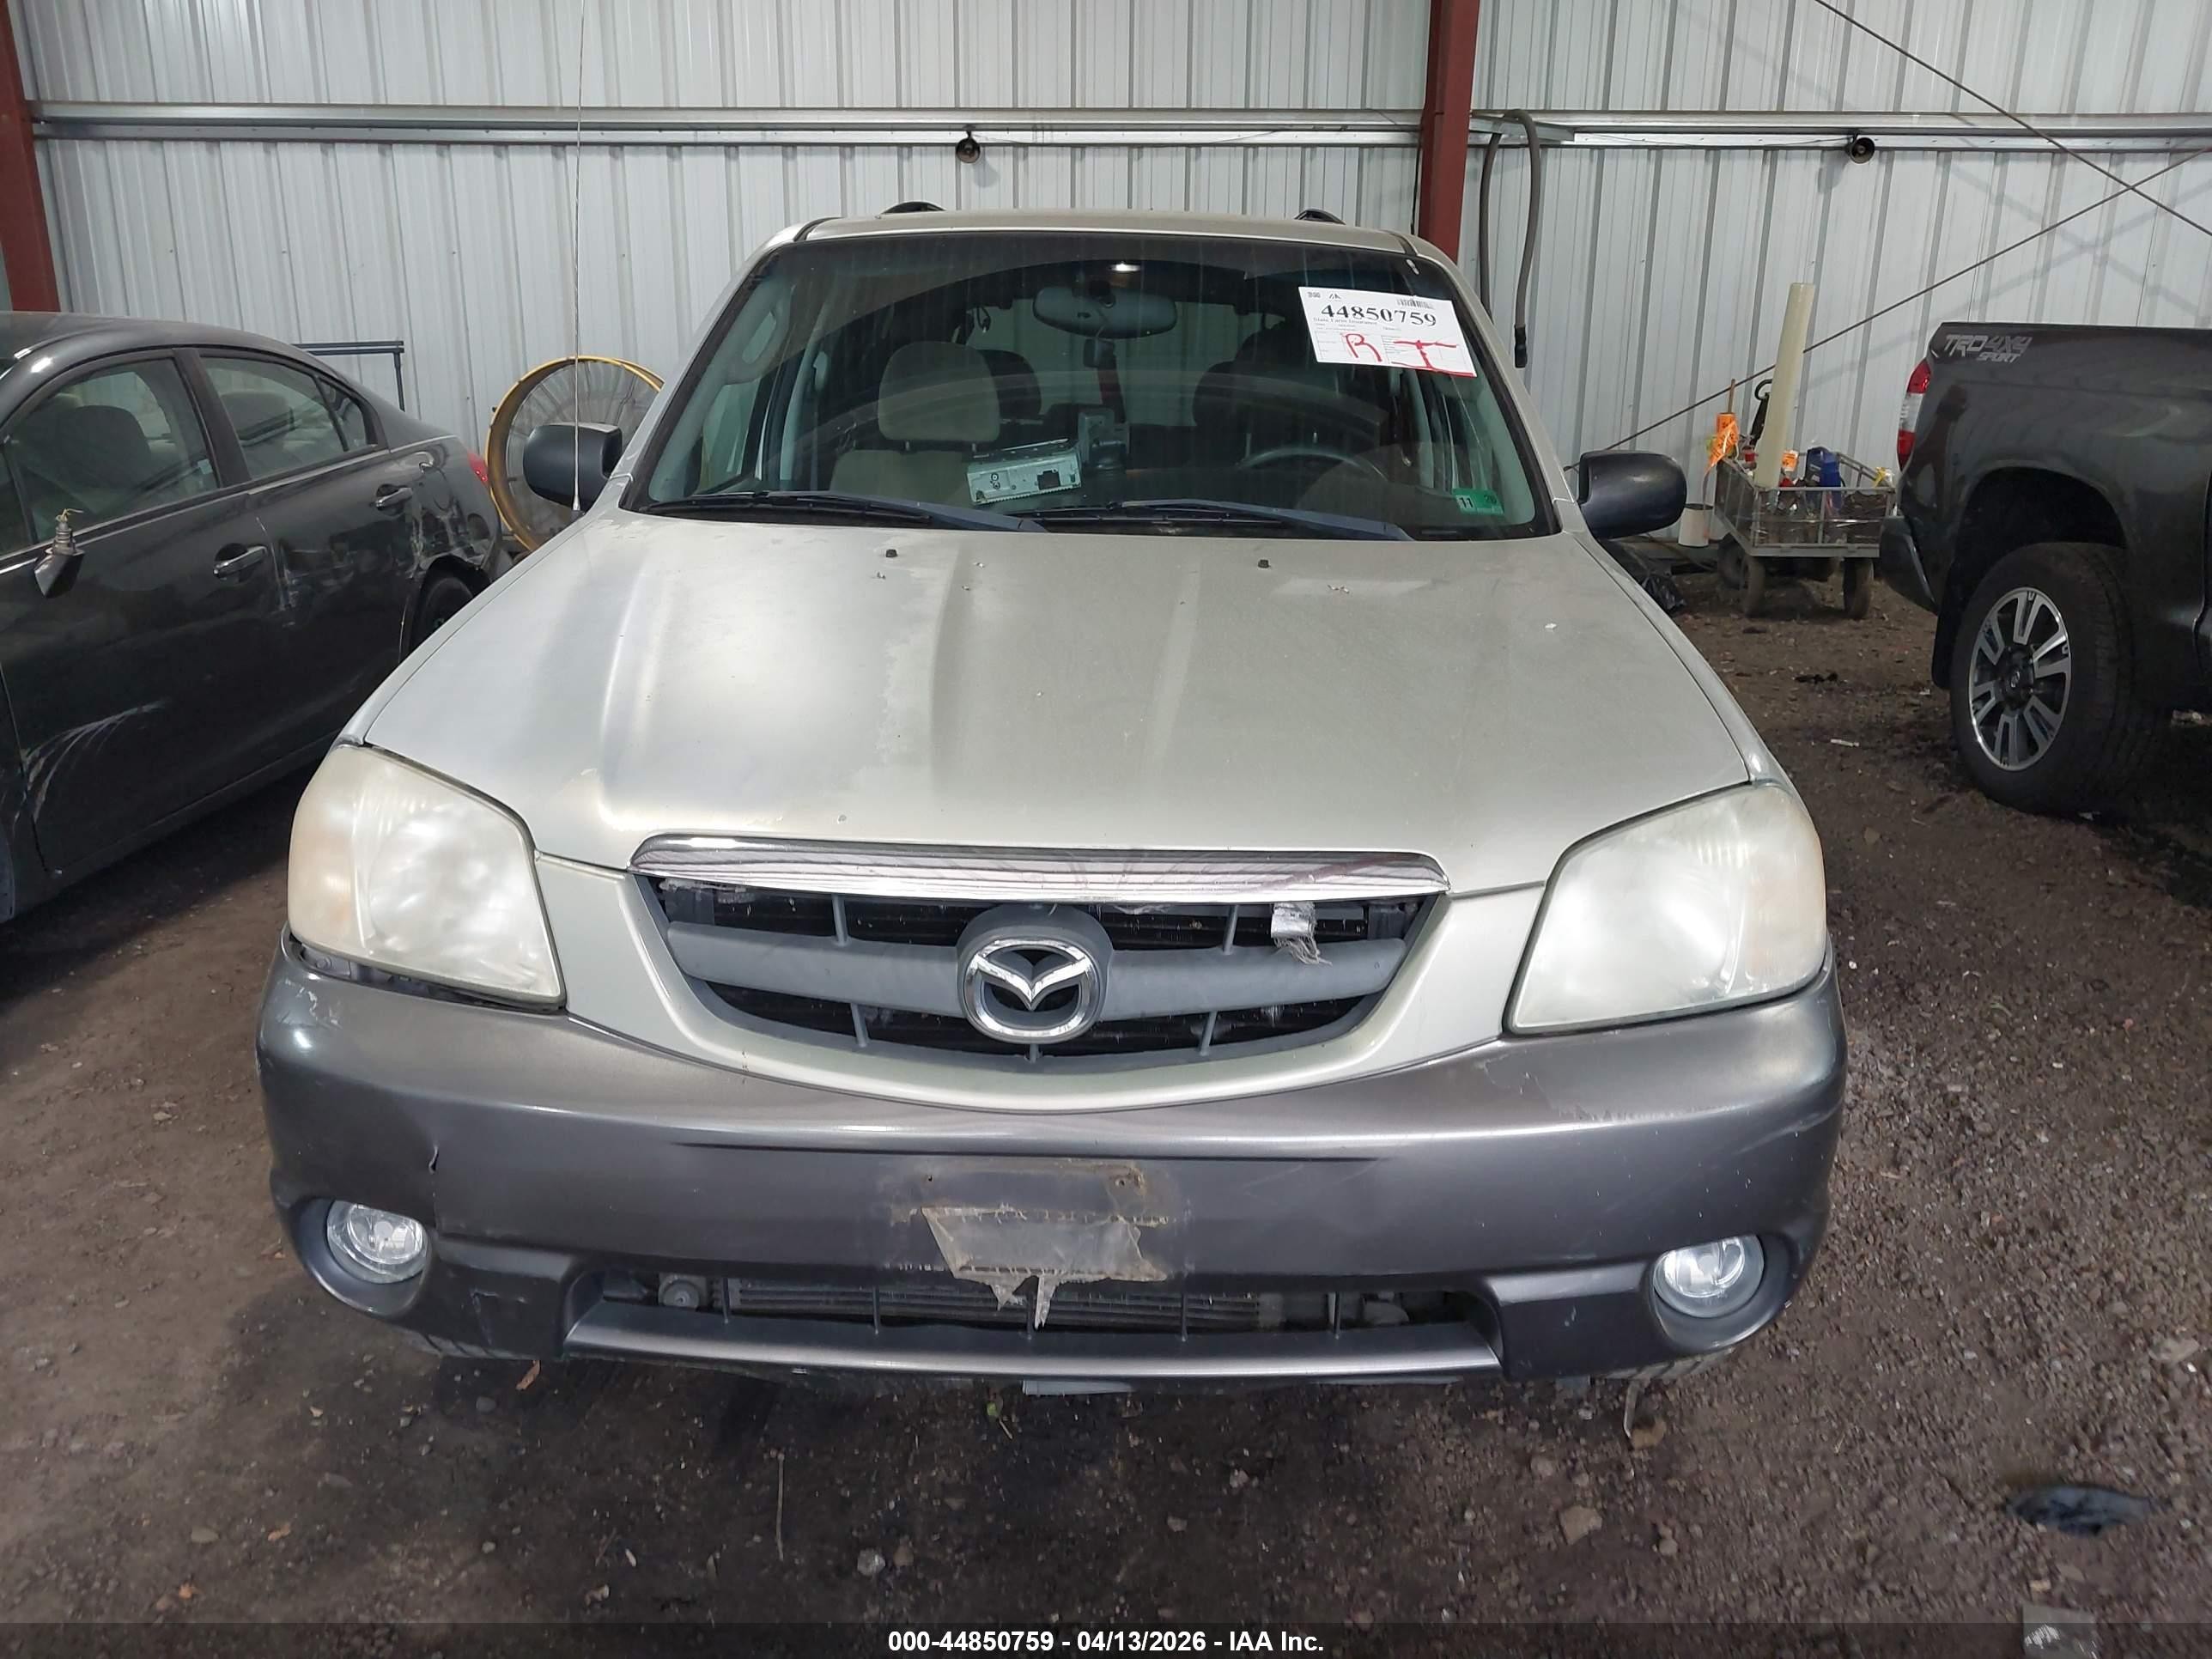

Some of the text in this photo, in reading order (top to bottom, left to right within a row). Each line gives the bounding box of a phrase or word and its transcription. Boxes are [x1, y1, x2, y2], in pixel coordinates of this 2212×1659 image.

[1321, 304, 1437, 327] 44850759
[1345, 332, 1383, 362] R
[1944, 334, 1989, 357] TRD
[1976, 351, 2021, 363] SPORT
[1460, 496, 1474, 508] 11
